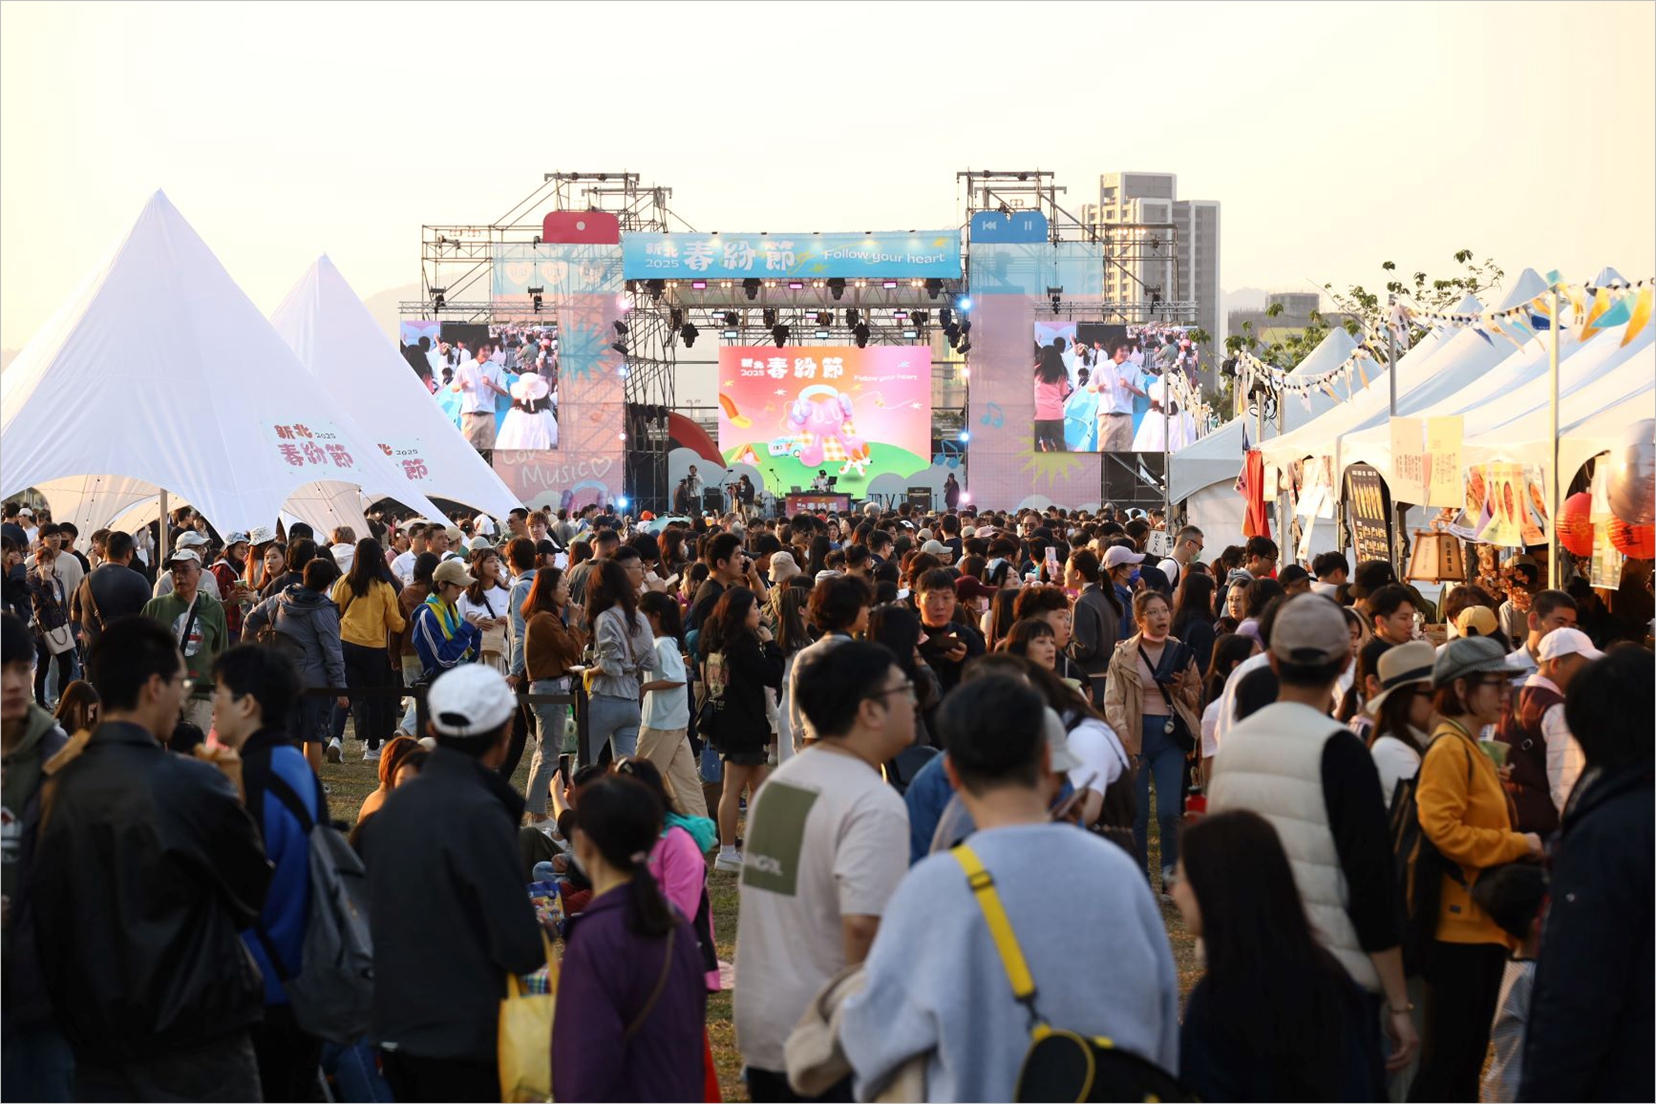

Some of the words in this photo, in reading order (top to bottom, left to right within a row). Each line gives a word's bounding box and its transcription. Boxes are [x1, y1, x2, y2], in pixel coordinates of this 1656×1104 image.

[645, 242, 679, 258] 新北
[683, 240, 796, 272] 春紛節
[824, 248, 869, 260] Follow
[872, 252, 903, 263] your
[907, 252, 946, 264] heart
[645, 258, 680, 269] 2025
[740, 369, 765, 377] 2025
[766, 357, 844, 379] 春紛節
[274, 423, 313, 439] 新北
[277, 441, 354, 468] 春紛節
[502, 449, 553, 465] Lov
[521, 461, 589, 489] Music
